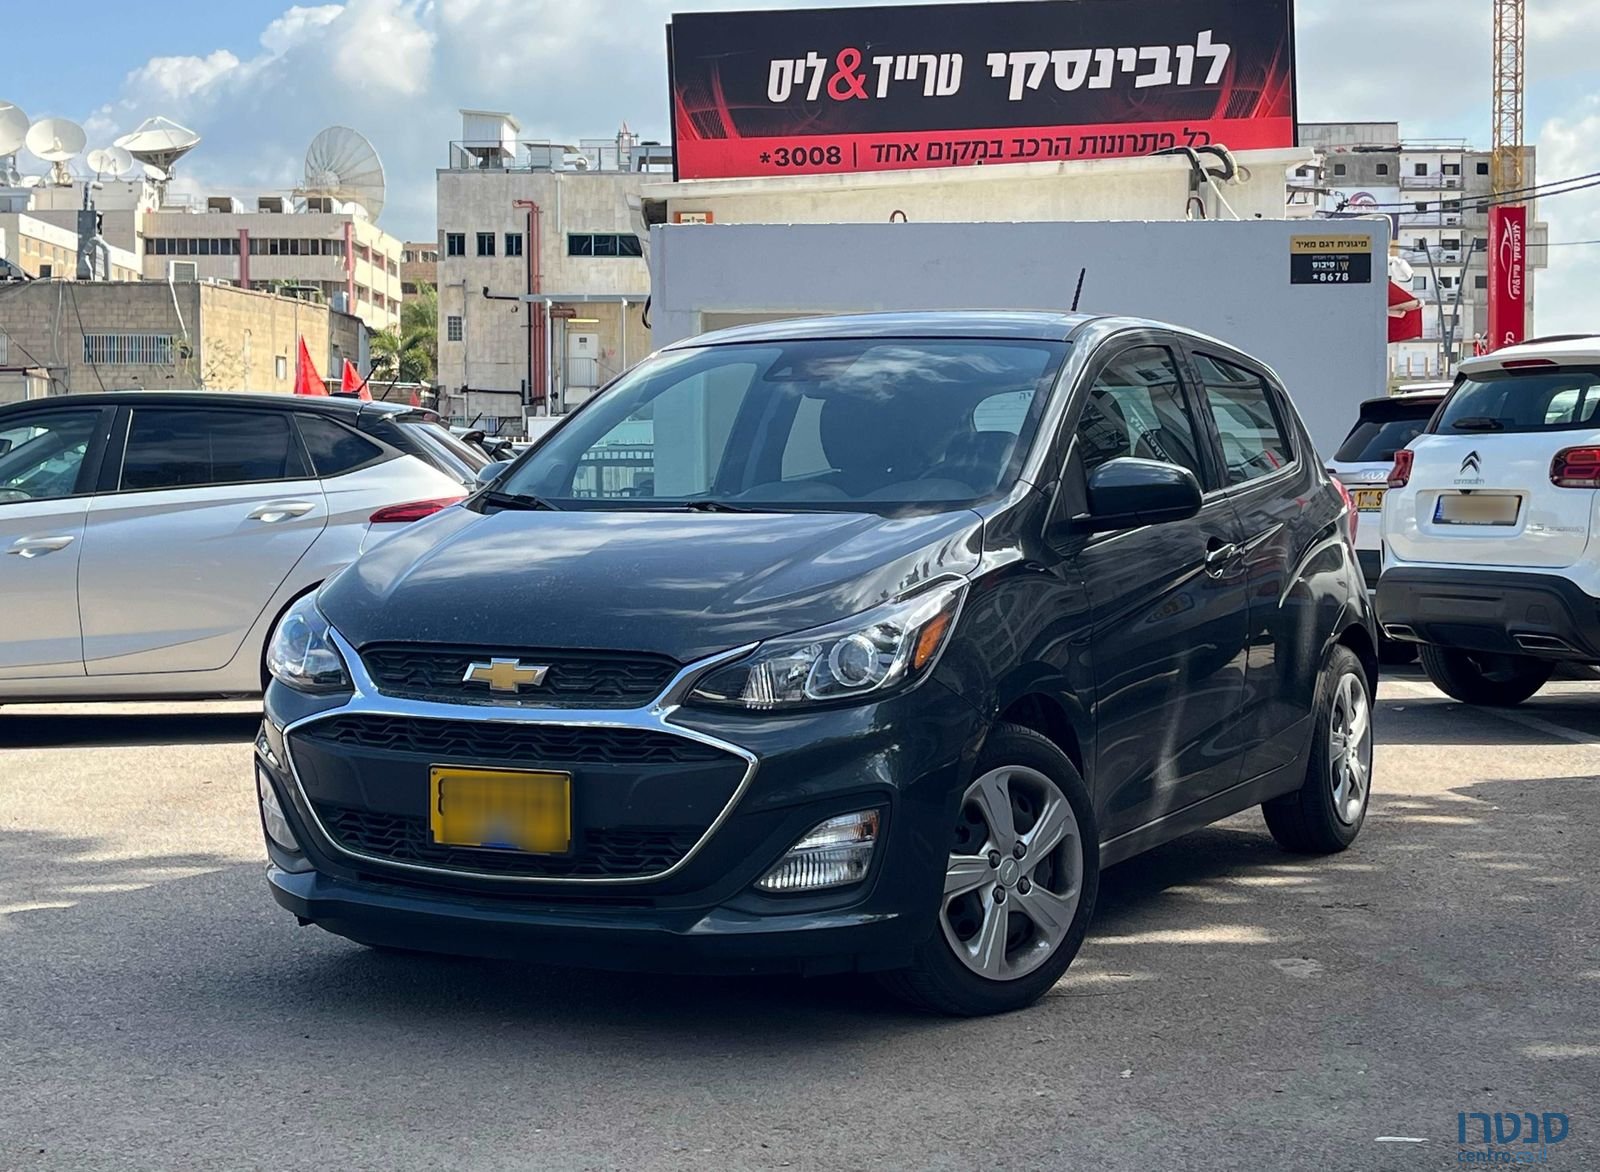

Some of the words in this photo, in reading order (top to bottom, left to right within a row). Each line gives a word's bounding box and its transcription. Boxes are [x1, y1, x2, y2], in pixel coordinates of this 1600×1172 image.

[986, 30, 1231, 101] לובינסקי
[1011, 136, 1072, 157] הרכב
[1078, 131, 1176, 155] פתרונות
[1183, 127, 1211, 147] כל
[870, 142, 920, 163] אחד
[926, 138, 1003, 165] במקום
[1295, 240, 1317, 249] מאיר
[1319, 240, 1334, 248] דגם
[1337, 240, 1367, 248] מיגונית
